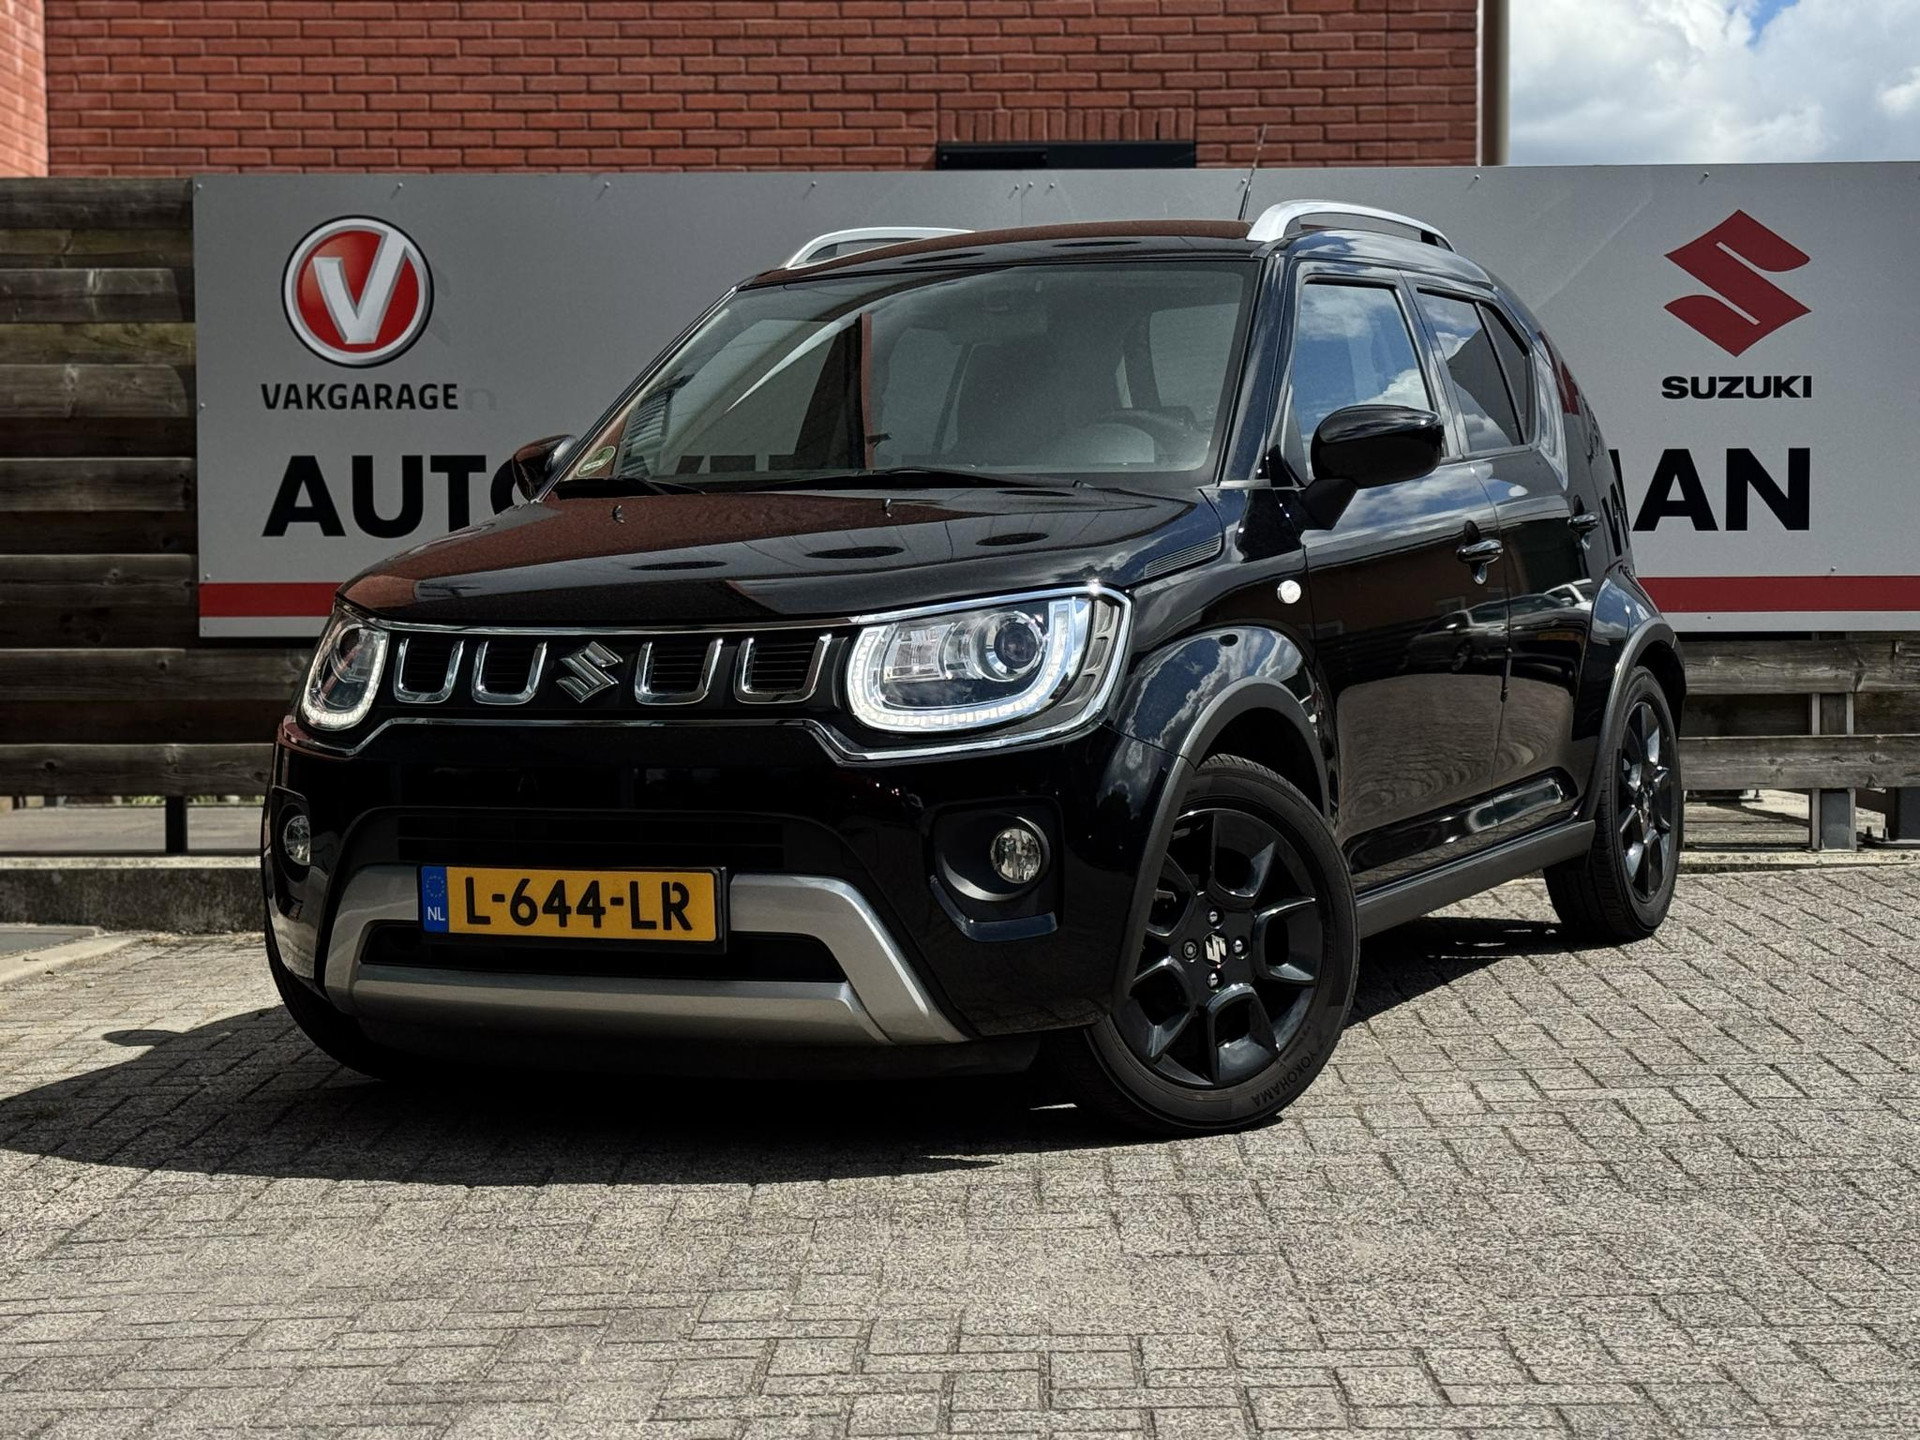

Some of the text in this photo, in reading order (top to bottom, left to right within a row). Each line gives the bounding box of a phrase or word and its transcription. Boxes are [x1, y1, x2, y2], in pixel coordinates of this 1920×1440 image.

[260, 383, 459, 410] VAKGARAGE
[1661, 375, 1812, 399] SUZUKI
[262, 454, 517, 539] AUT
[1608, 447, 1811, 531] AN
[427, 905, 446, 921] NL
[465, 876, 693, 931] L-644-LR
[1250, 1049, 1317, 1107] YOKOHAMA
